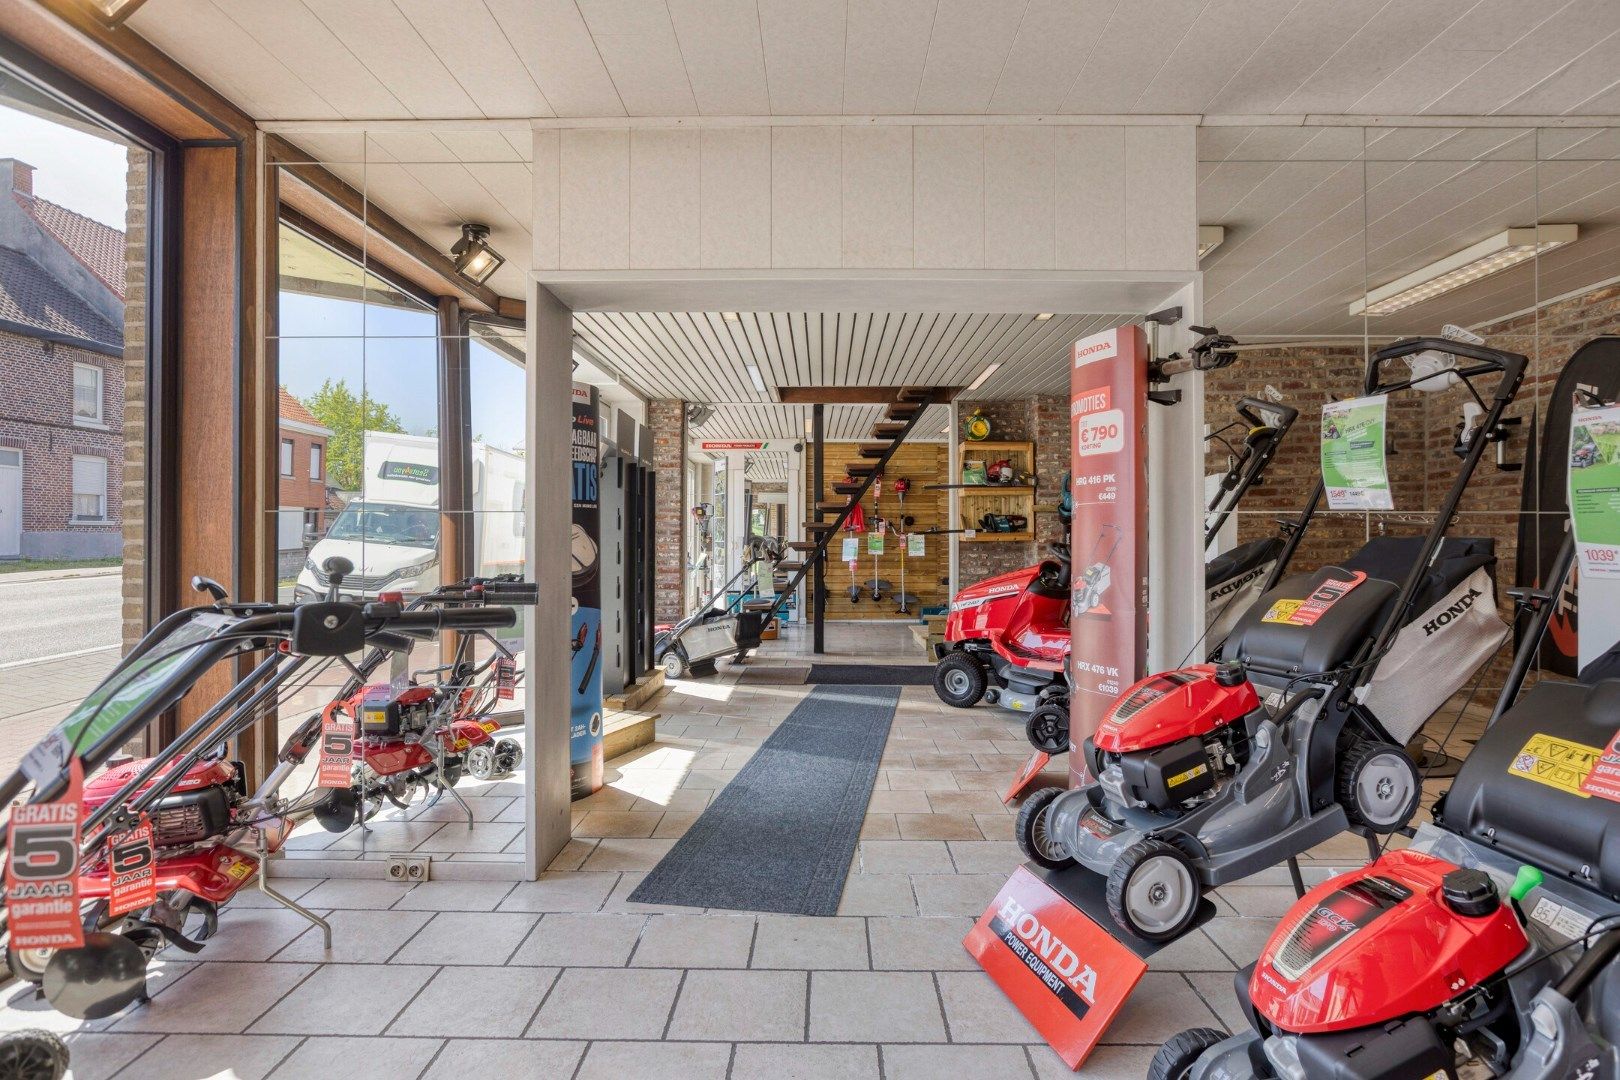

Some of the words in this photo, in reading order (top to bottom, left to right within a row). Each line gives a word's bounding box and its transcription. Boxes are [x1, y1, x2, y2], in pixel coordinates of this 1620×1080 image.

[1077, 342, 1111, 358] HONDA
[577, 415, 594, 426] Live
[1091, 424, 1118, 441] 790
[1103, 474, 1116, 483] PK
[989, 584, 1019, 594] HONDA
[1312, 586, 1346, 602] 5
[1422, 588, 1482, 637] HONDA
[1077, 661, 1090, 672] HRX
[1091, 665, 1105, 675] 476
[1106, 667, 1119, 677] VK
[1099, 683, 1119, 694] €1039
[325, 723, 353, 732] GRATIS
[323, 731, 353, 755] 5
[322, 764, 350, 772] garantie
[12, 802, 78, 824] GRATIS
[1090, 814, 1112, 829] HONDA
[10, 822, 78, 881] 5
[112, 836, 153, 875] 5
[112, 868, 152, 887] JAAR
[8, 881, 74, 899] JAAR
[113, 878, 152, 897] garantie
[11, 901, 73, 919] garantie
[113, 897, 152, 912] HONDA
[1534, 906, 1550, 921] 95
[15, 933, 76, 946] HONDA
[997, 896, 1098, 1005] HONDA
[1004, 931, 1029, 960] POWER
[1024, 955, 1066, 995] EQUIPMENT
[1261, 971, 1287, 995] HONDA
